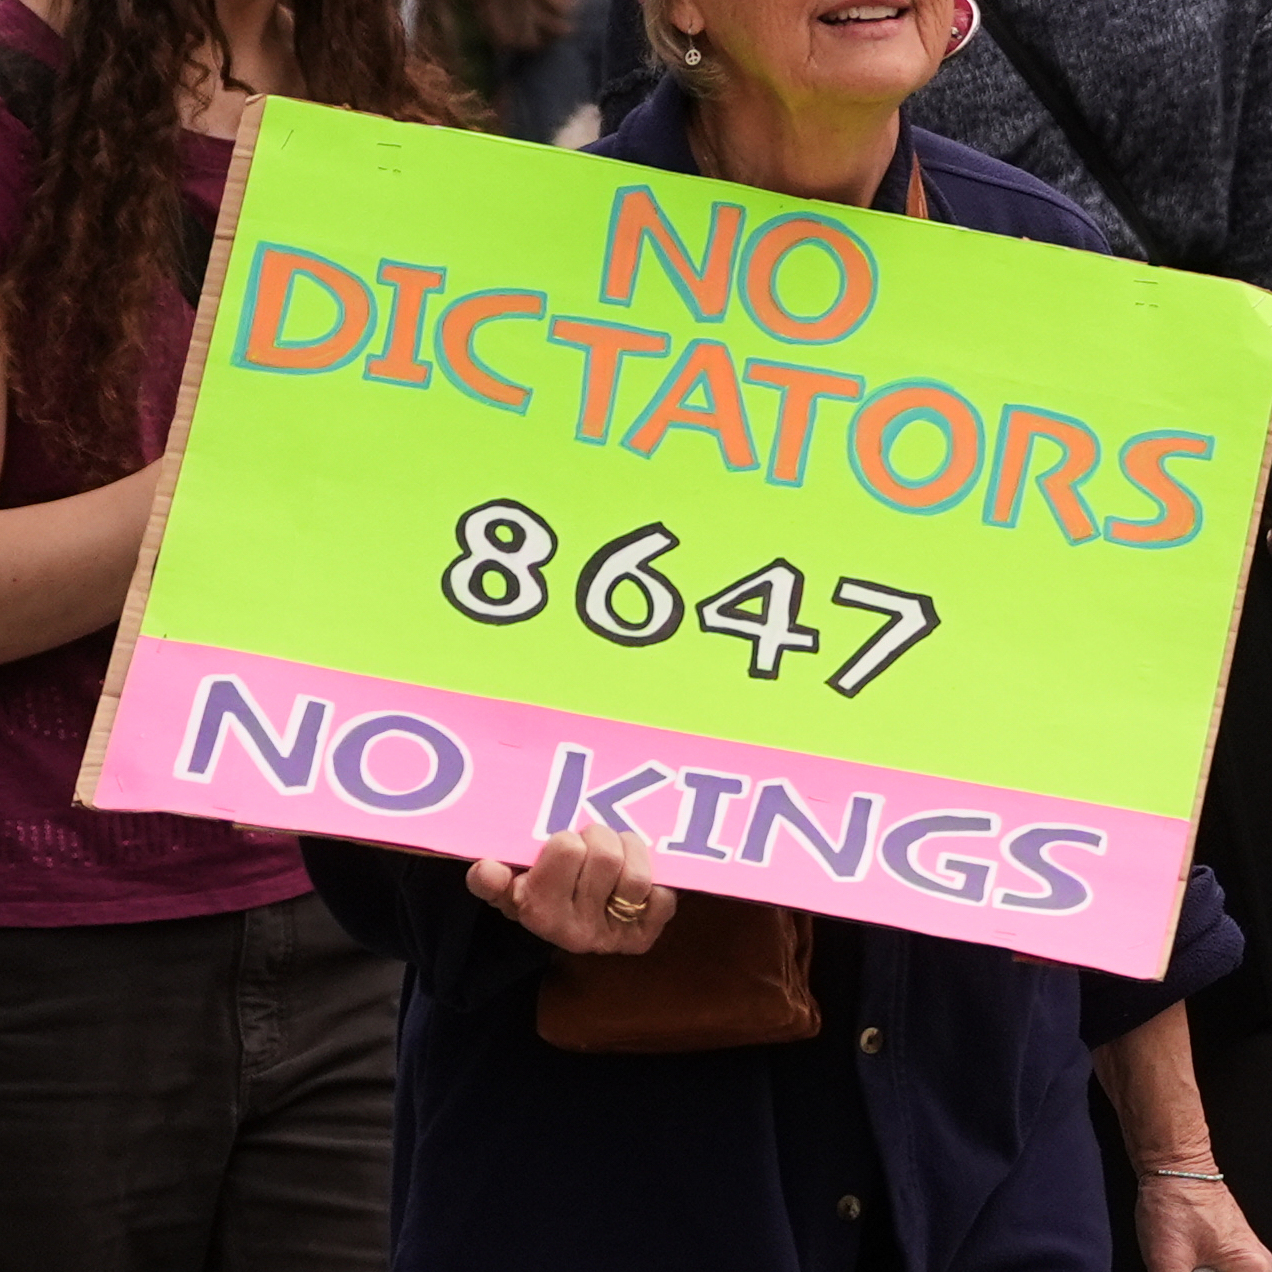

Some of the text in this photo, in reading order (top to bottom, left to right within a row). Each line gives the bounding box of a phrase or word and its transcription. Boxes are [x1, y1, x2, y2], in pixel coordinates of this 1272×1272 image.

[601, 183, 879, 346] NO
[234, 240, 1214, 548] DICTATORS
[442, 498, 941, 698] 8647
[175, 674, 1107, 917] NO KINGS
